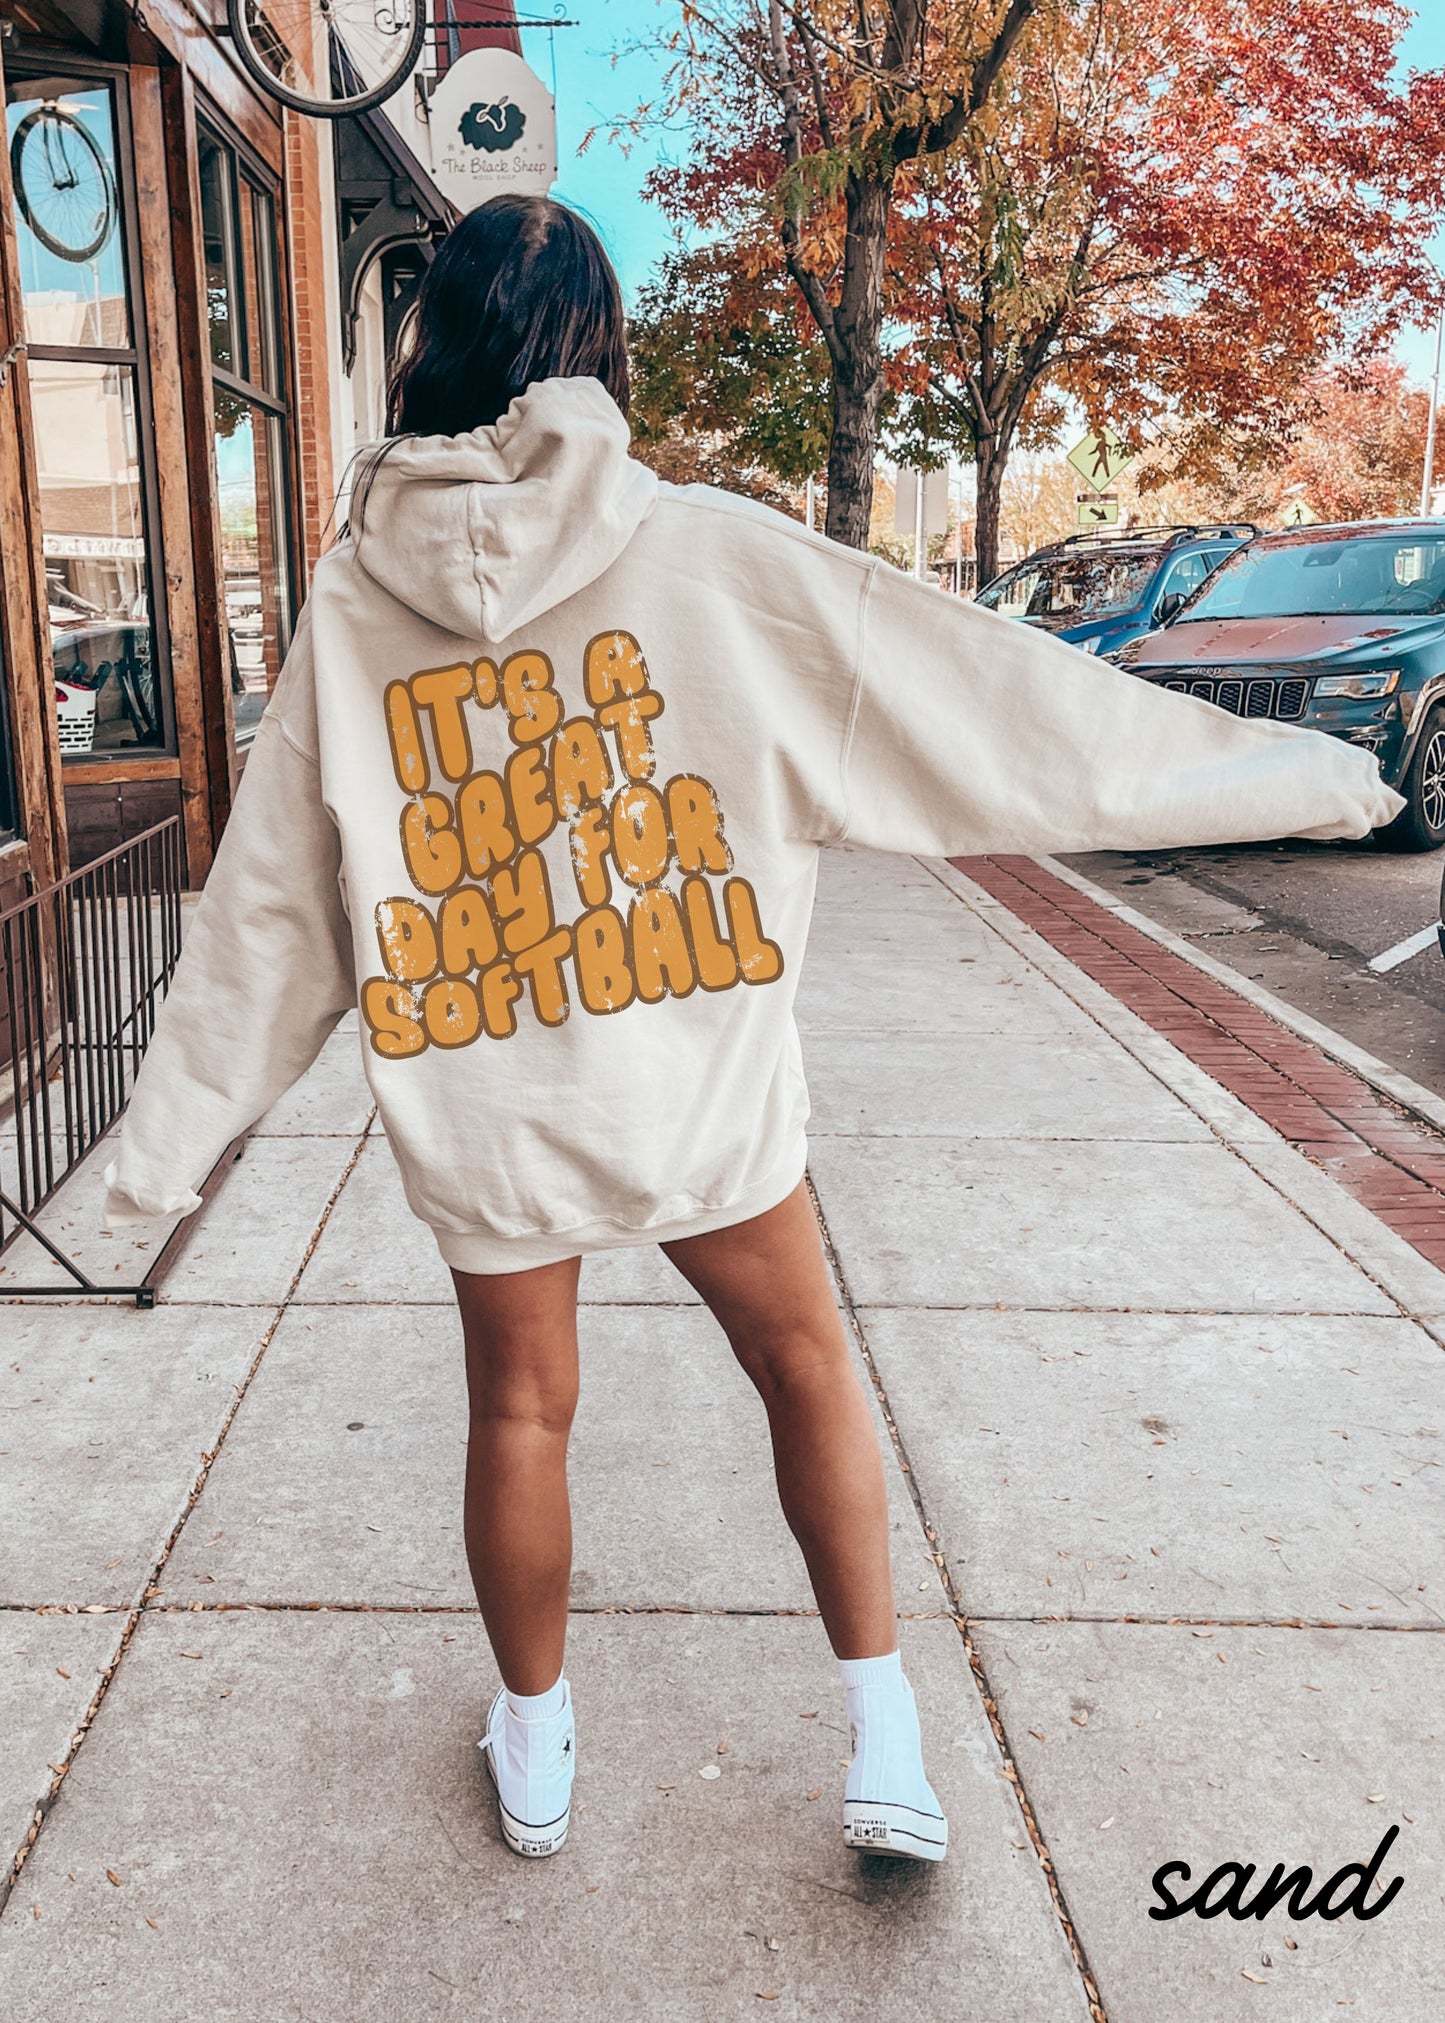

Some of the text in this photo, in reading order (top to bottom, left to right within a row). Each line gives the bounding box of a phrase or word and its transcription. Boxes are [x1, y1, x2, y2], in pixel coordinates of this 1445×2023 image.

[442, 156, 547, 175] The Black Sheep
[384, 630, 651, 796] IT'S A
[1191, 666, 1221, 676] Jeep
[399, 690, 665, 897] GREAT
[375, 773, 735, 984] DAY FOR
[361, 874, 785, 1061] SOFTBALL
[853, 1818, 886, 1826] CONVERSE
